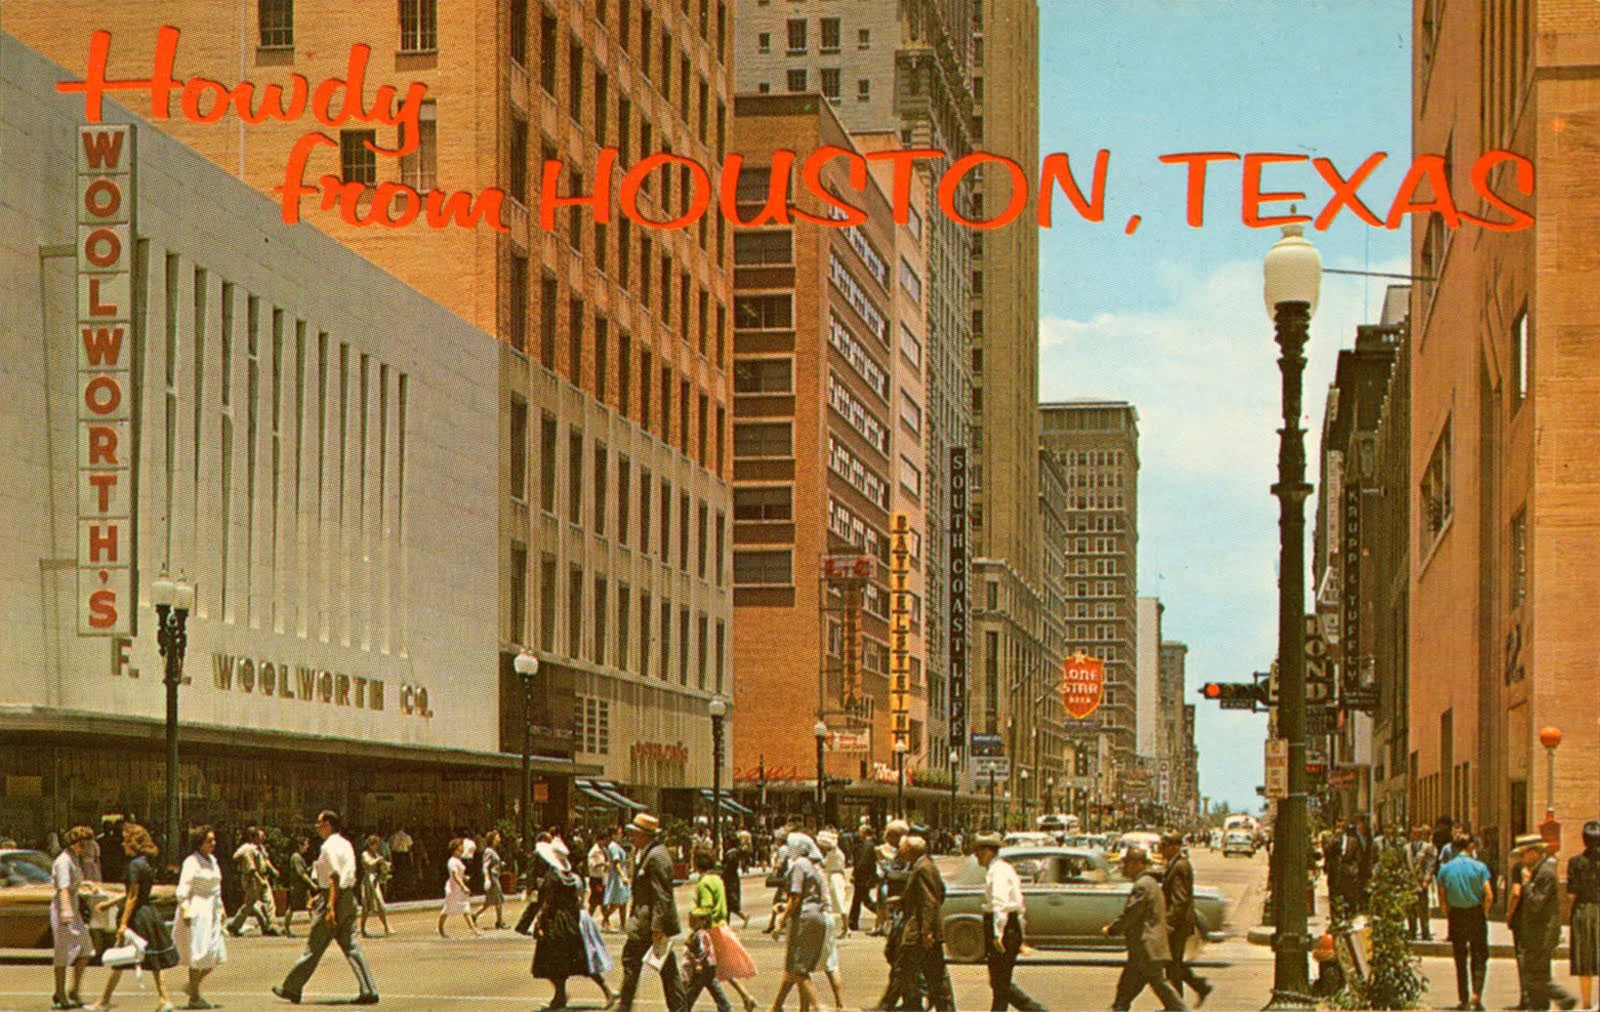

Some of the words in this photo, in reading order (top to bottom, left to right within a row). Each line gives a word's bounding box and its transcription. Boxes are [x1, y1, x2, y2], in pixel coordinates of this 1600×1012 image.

[82, 131, 124, 628] WOOLWORTH'S
[951, 454, 964, 549] SOUTH
[951, 558, 964, 652] COAST
[212, 653, 385, 712] WOOLWORTH
[400, 683, 434, 719] CO.
[951, 661, 964, 737] LIFE
